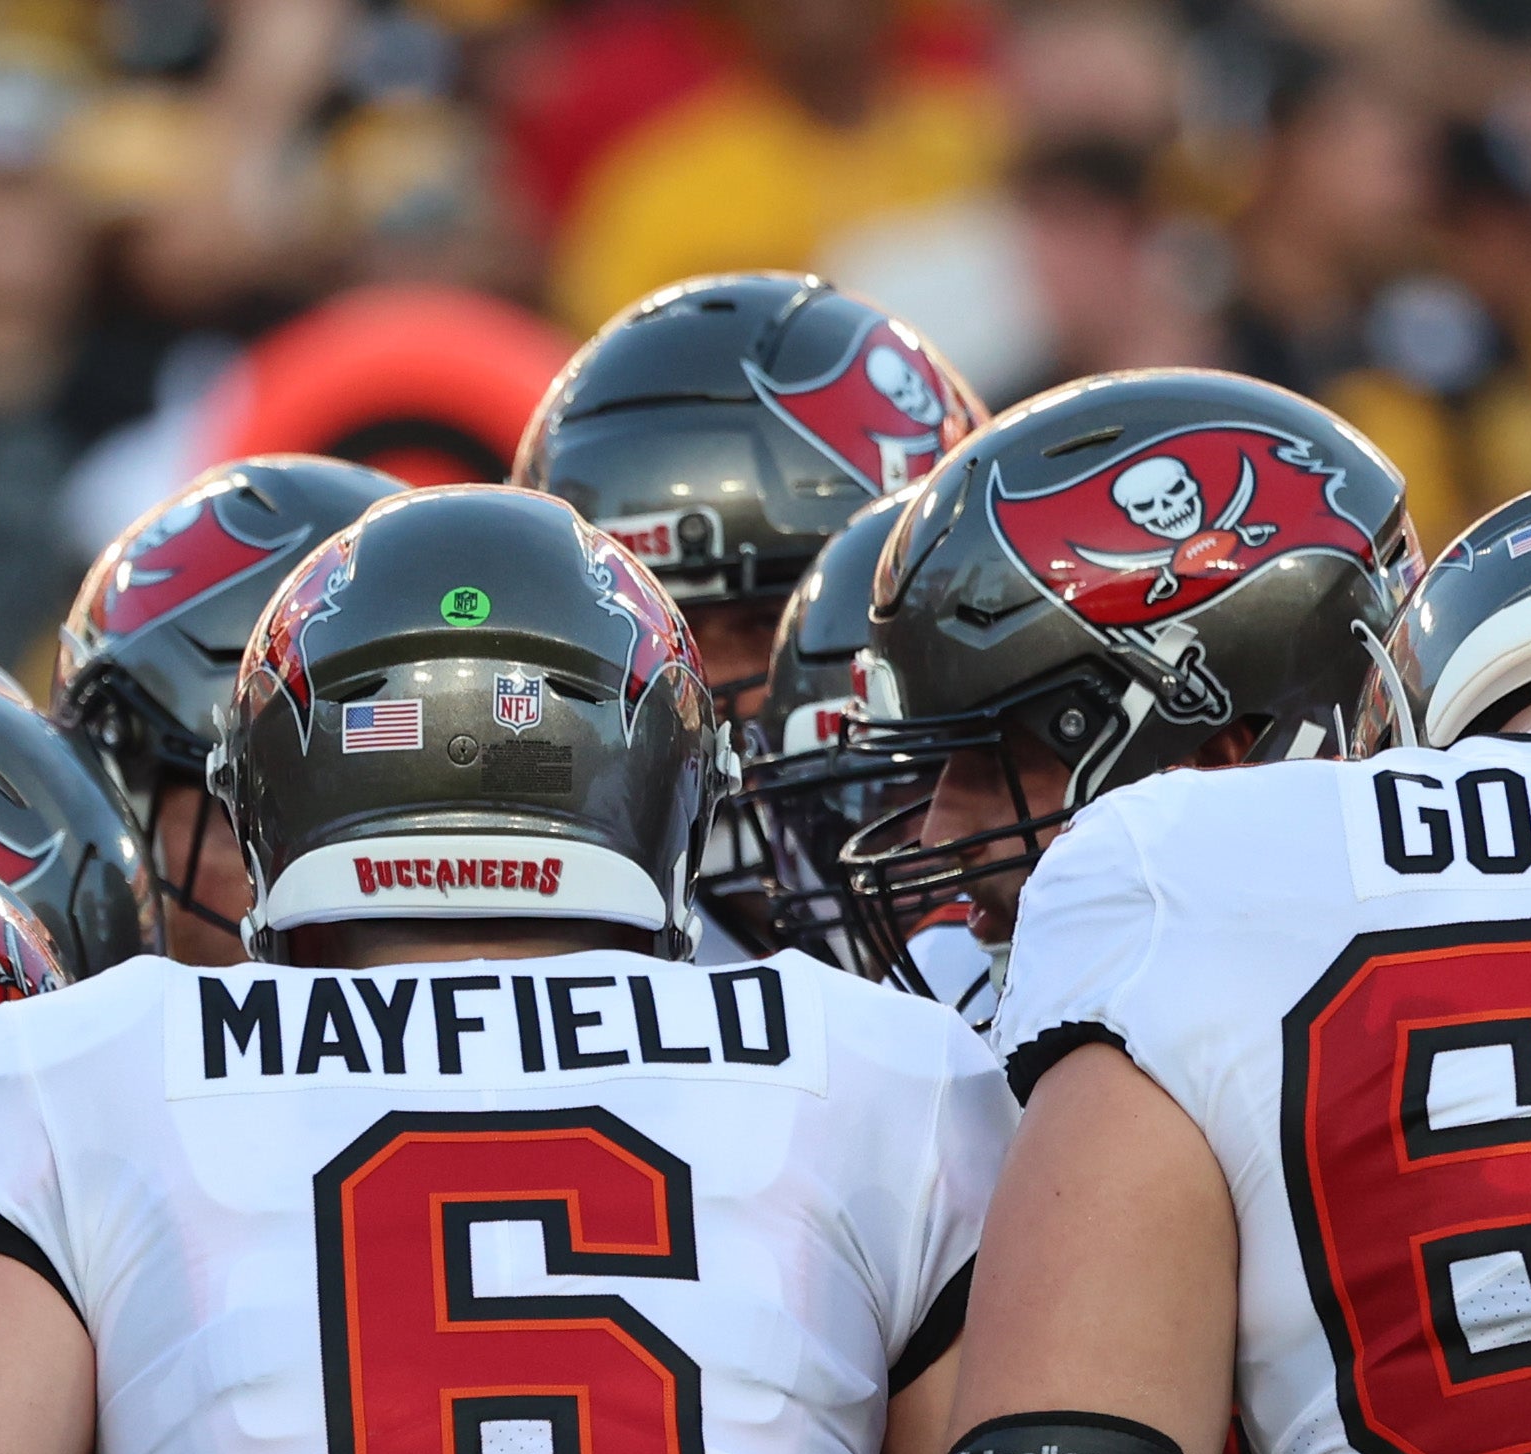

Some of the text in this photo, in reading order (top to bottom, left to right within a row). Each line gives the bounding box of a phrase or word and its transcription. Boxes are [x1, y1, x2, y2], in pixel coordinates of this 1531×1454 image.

[455, 600, 478, 611] NFL
[500, 697, 535, 723] NFL
[353, 857, 563, 898] BUCCANEERS
[200, 966, 792, 1079] MAYFIELD
